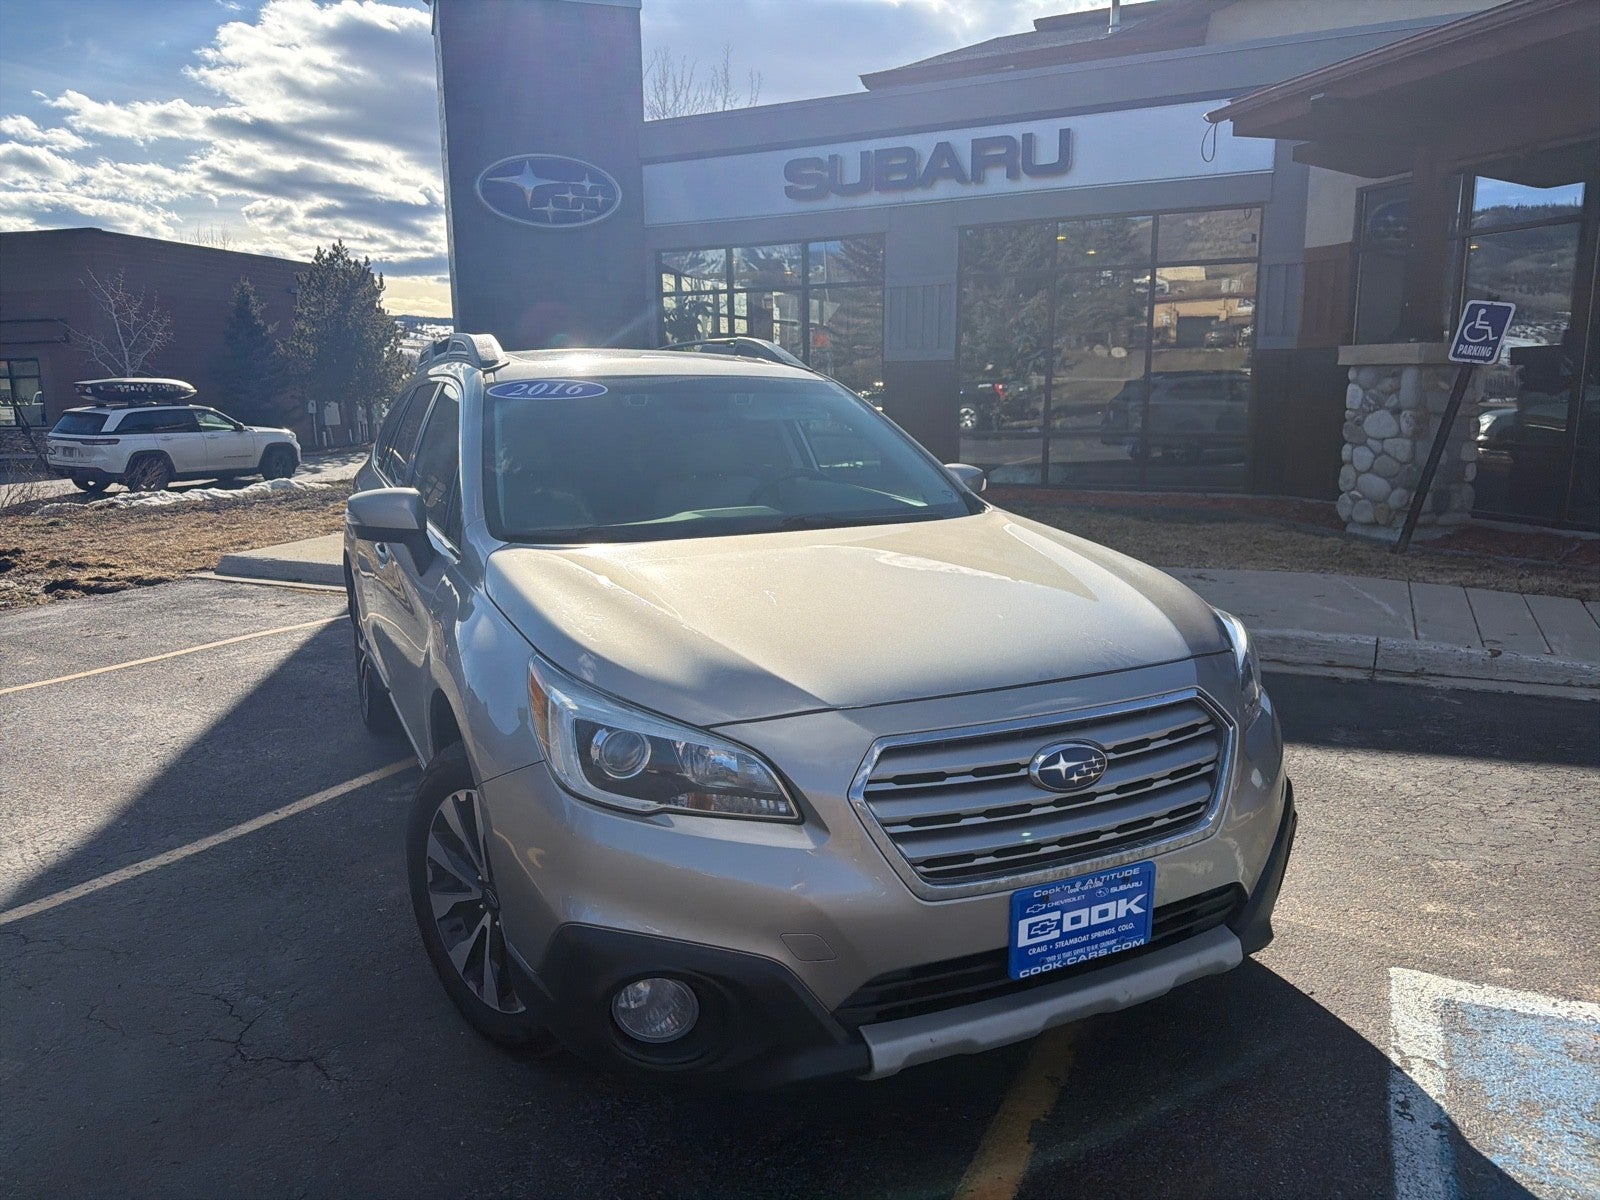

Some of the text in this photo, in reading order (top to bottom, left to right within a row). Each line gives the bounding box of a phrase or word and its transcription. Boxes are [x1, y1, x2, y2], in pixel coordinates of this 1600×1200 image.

[783, 128, 1073, 200] SUBARU
[1457, 344, 1493, 357] PARKING
[506, 382, 586, 396] 2016
[1033, 884, 1071, 898] Cook'n
[1085, 867, 1140, 887] ALTITUDE
[1110, 881, 1143, 893] SUBARU
[1047, 894, 1086, 908] CHEVROLET
[1028, 944, 1048, 956] CRAIG
[1055, 935, 1089, 950] STEAMBOAT
